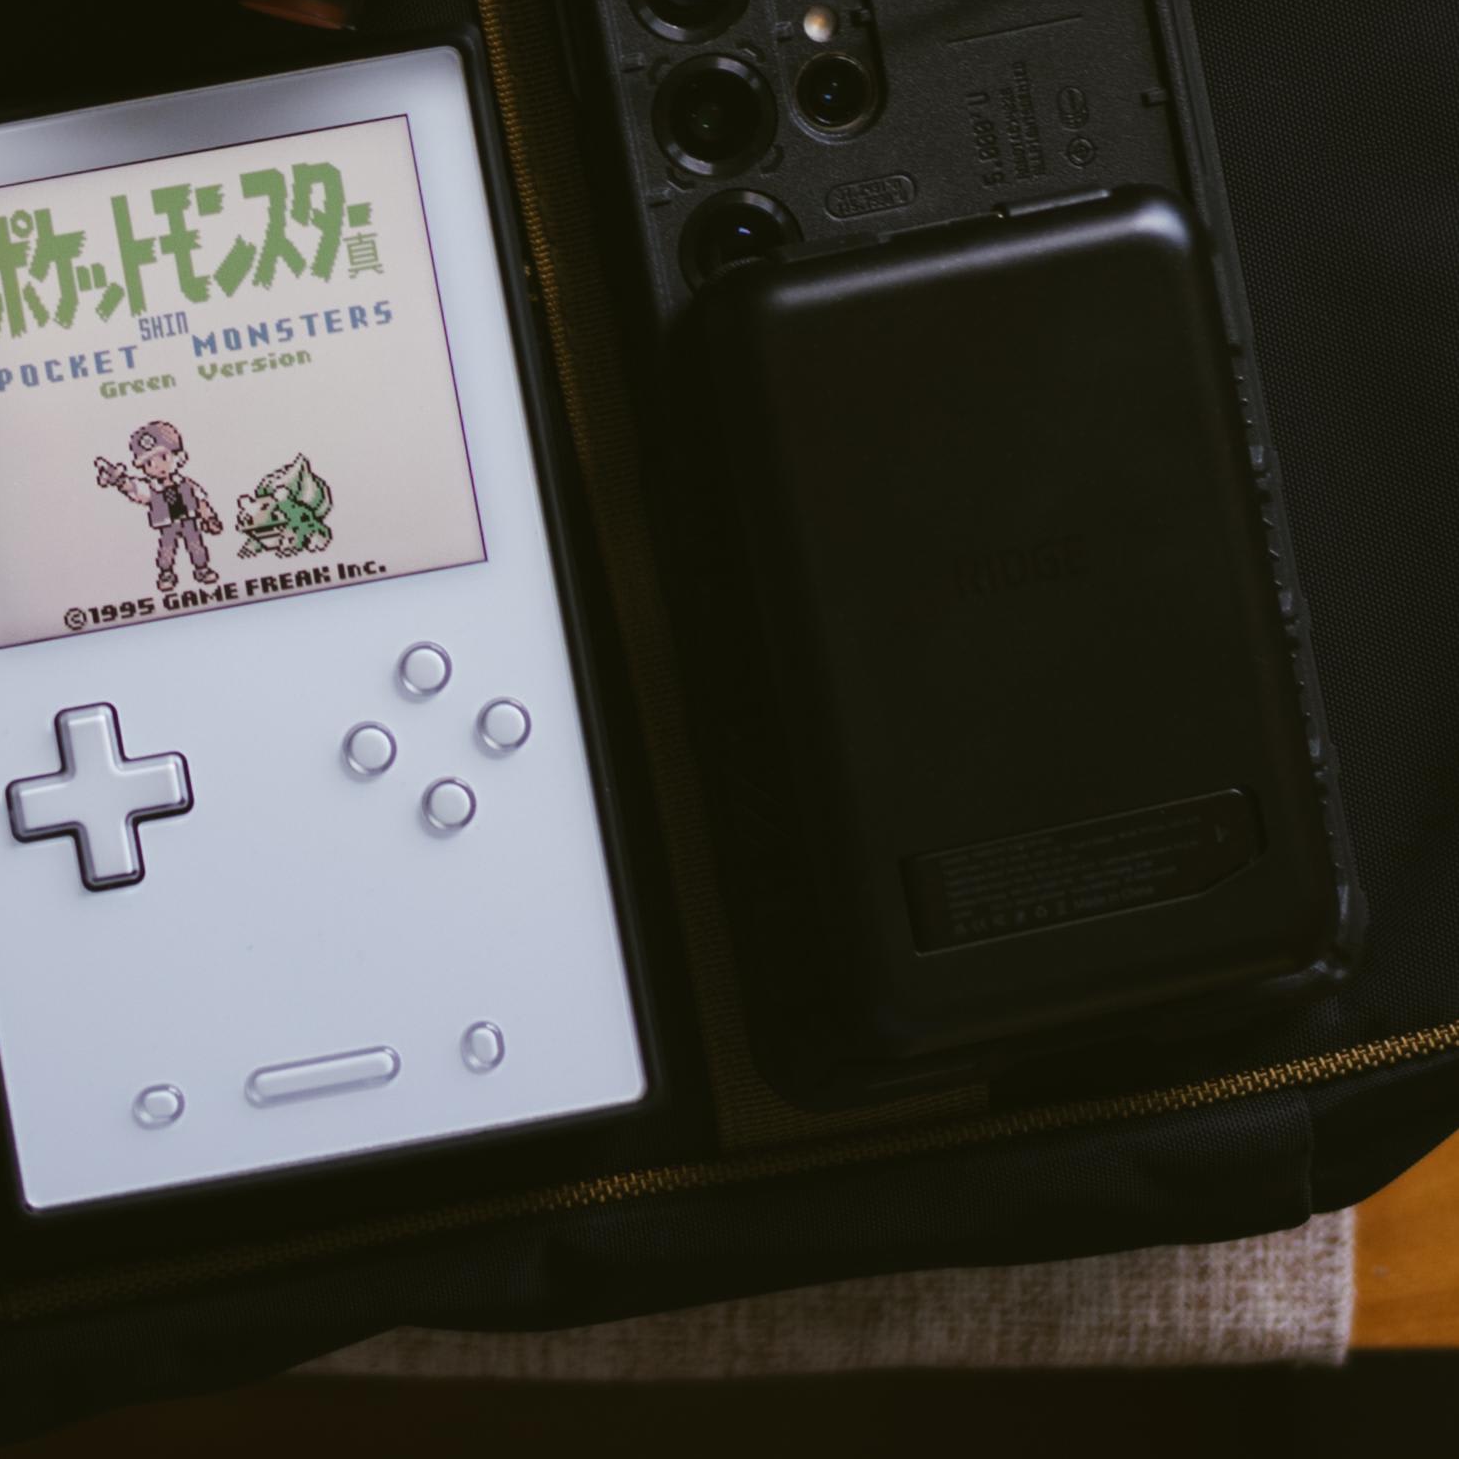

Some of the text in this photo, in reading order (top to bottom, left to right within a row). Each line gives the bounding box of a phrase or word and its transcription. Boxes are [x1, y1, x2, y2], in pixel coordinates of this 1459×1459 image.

[343, 232, 384, 279] 真
[192, 300, 394, 358] MONSTERS
[99, 349, 312, 399] Green Version
[64, 559, 387, 631] ©1995 GAME FREAK Inc.
